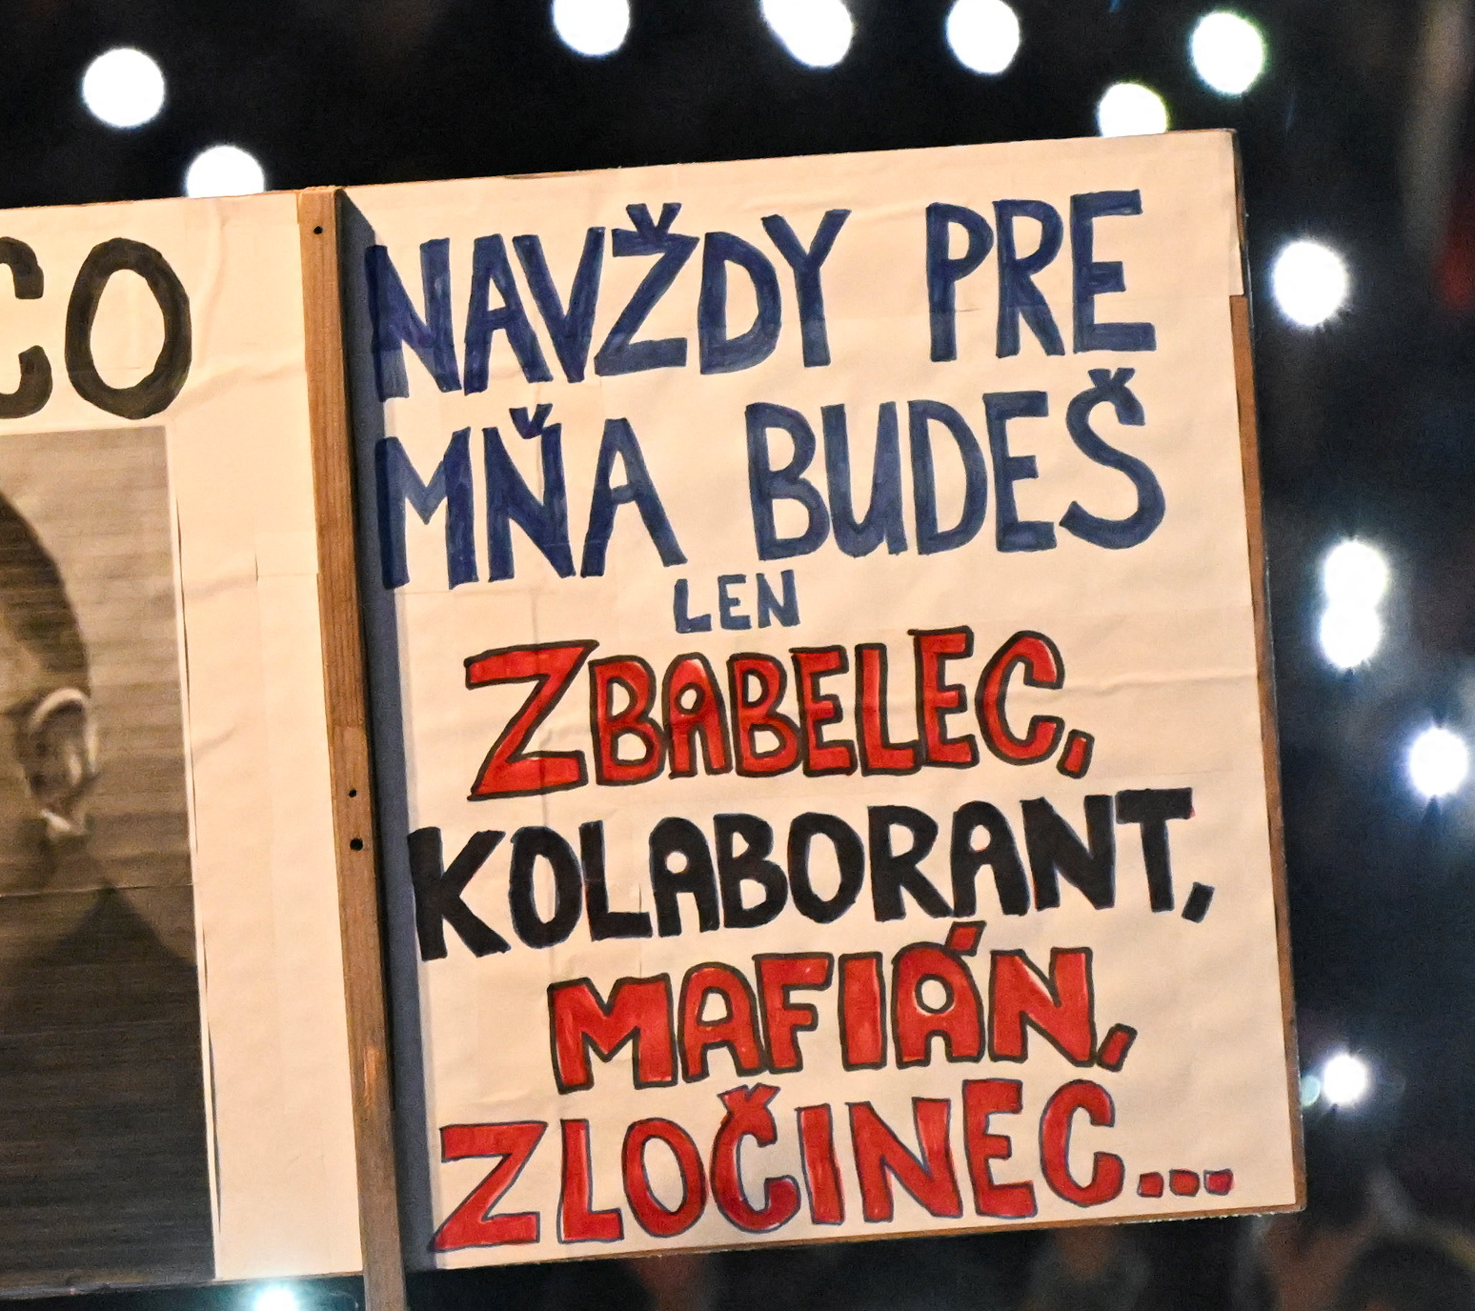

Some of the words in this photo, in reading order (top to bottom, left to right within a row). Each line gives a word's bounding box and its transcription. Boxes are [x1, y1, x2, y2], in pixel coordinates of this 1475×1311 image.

[366, 201, 850, 401] NAVŽDY
[924, 189, 1157, 364] PRE
[371, 403, 687, 590] MŇA
[744, 368, 1165, 561] BUDEŠ
[673, 567, 800, 632] LEN
[464, 625, 1095, 802] ZBABELEC,
[406, 788, 1214, 960] KOLABORANT,
[547, 922, 1134, 1091] MAFIÁN,
[428, 1080, 1235, 1252] ZLOČINEC...
